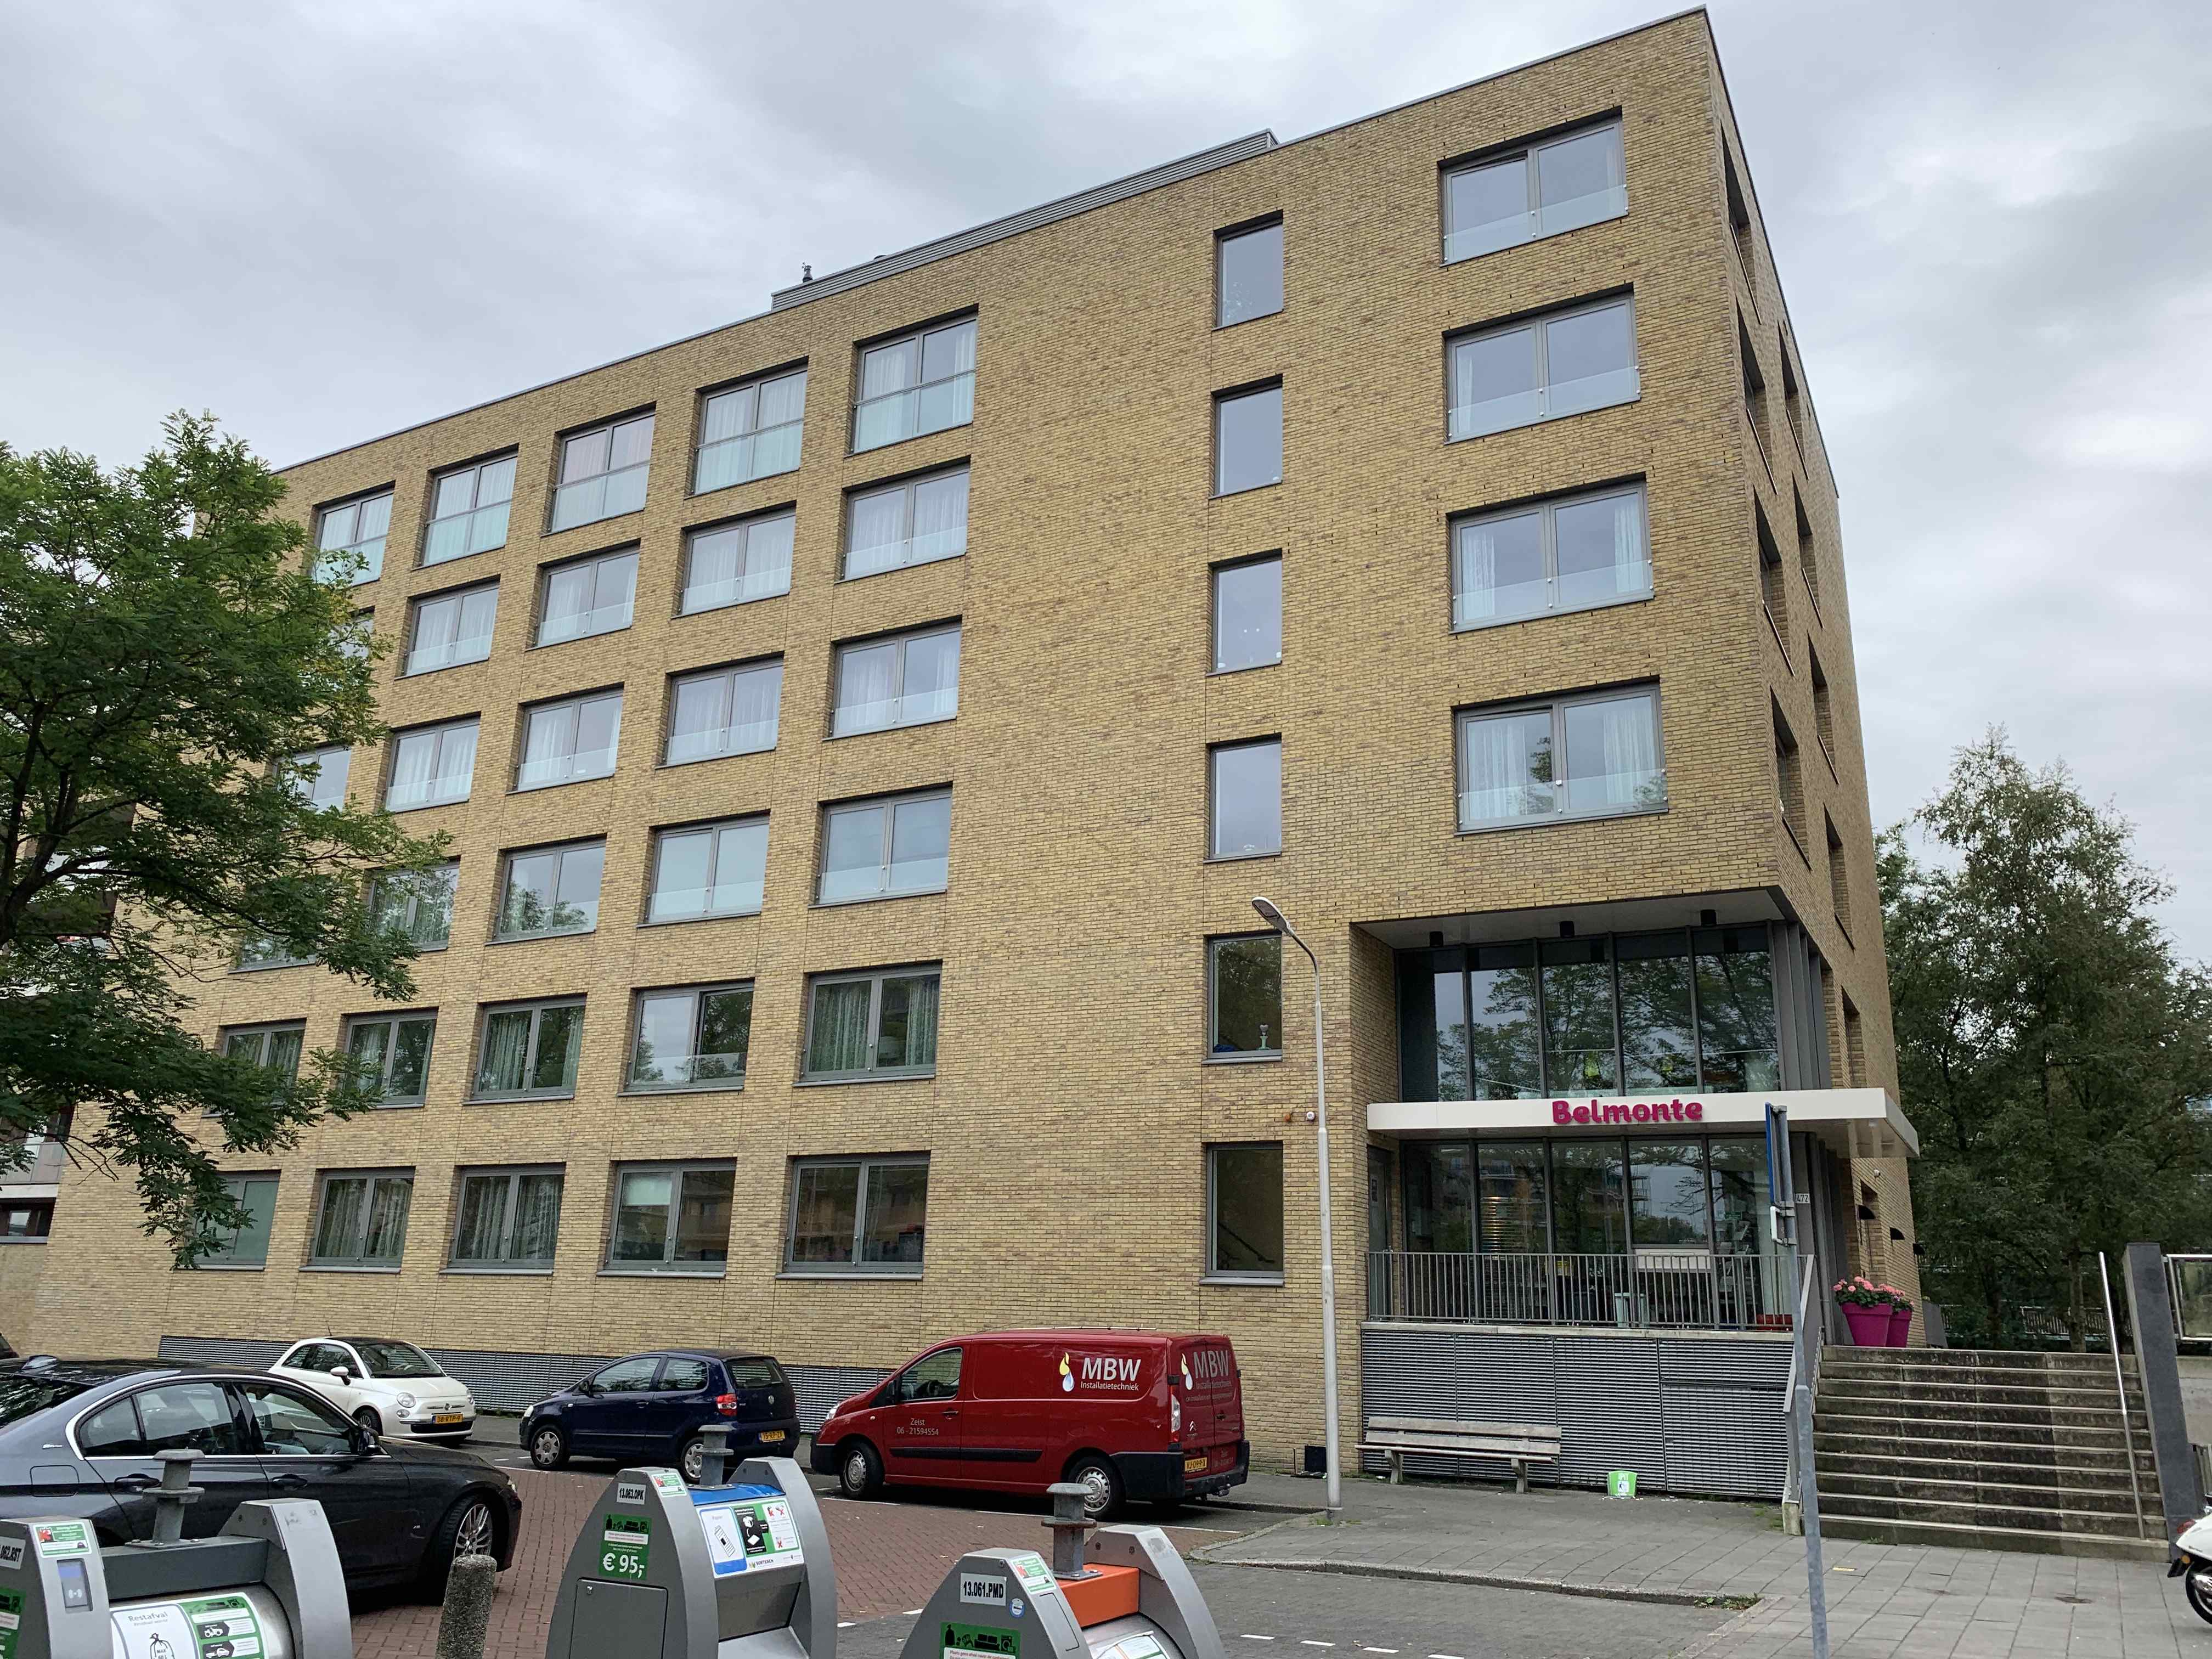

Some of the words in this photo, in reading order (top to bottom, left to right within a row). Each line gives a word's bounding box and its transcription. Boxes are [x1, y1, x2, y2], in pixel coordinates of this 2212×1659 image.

[1552, 1099, 1703, 1124] Belmonte
[1081, 1357, 1142, 1381] MBW
[1193, 1350, 1229, 1379] MBW
[1081, 1381, 1139, 1391] Installatietechniek
[910, 1418, 926, 1426] Zeist
[603, 1553, 616, 1571] €
[963, 1581, 1004, 1599] 13.061.PMD
[128, 1611, 168, 1622] Restafval
